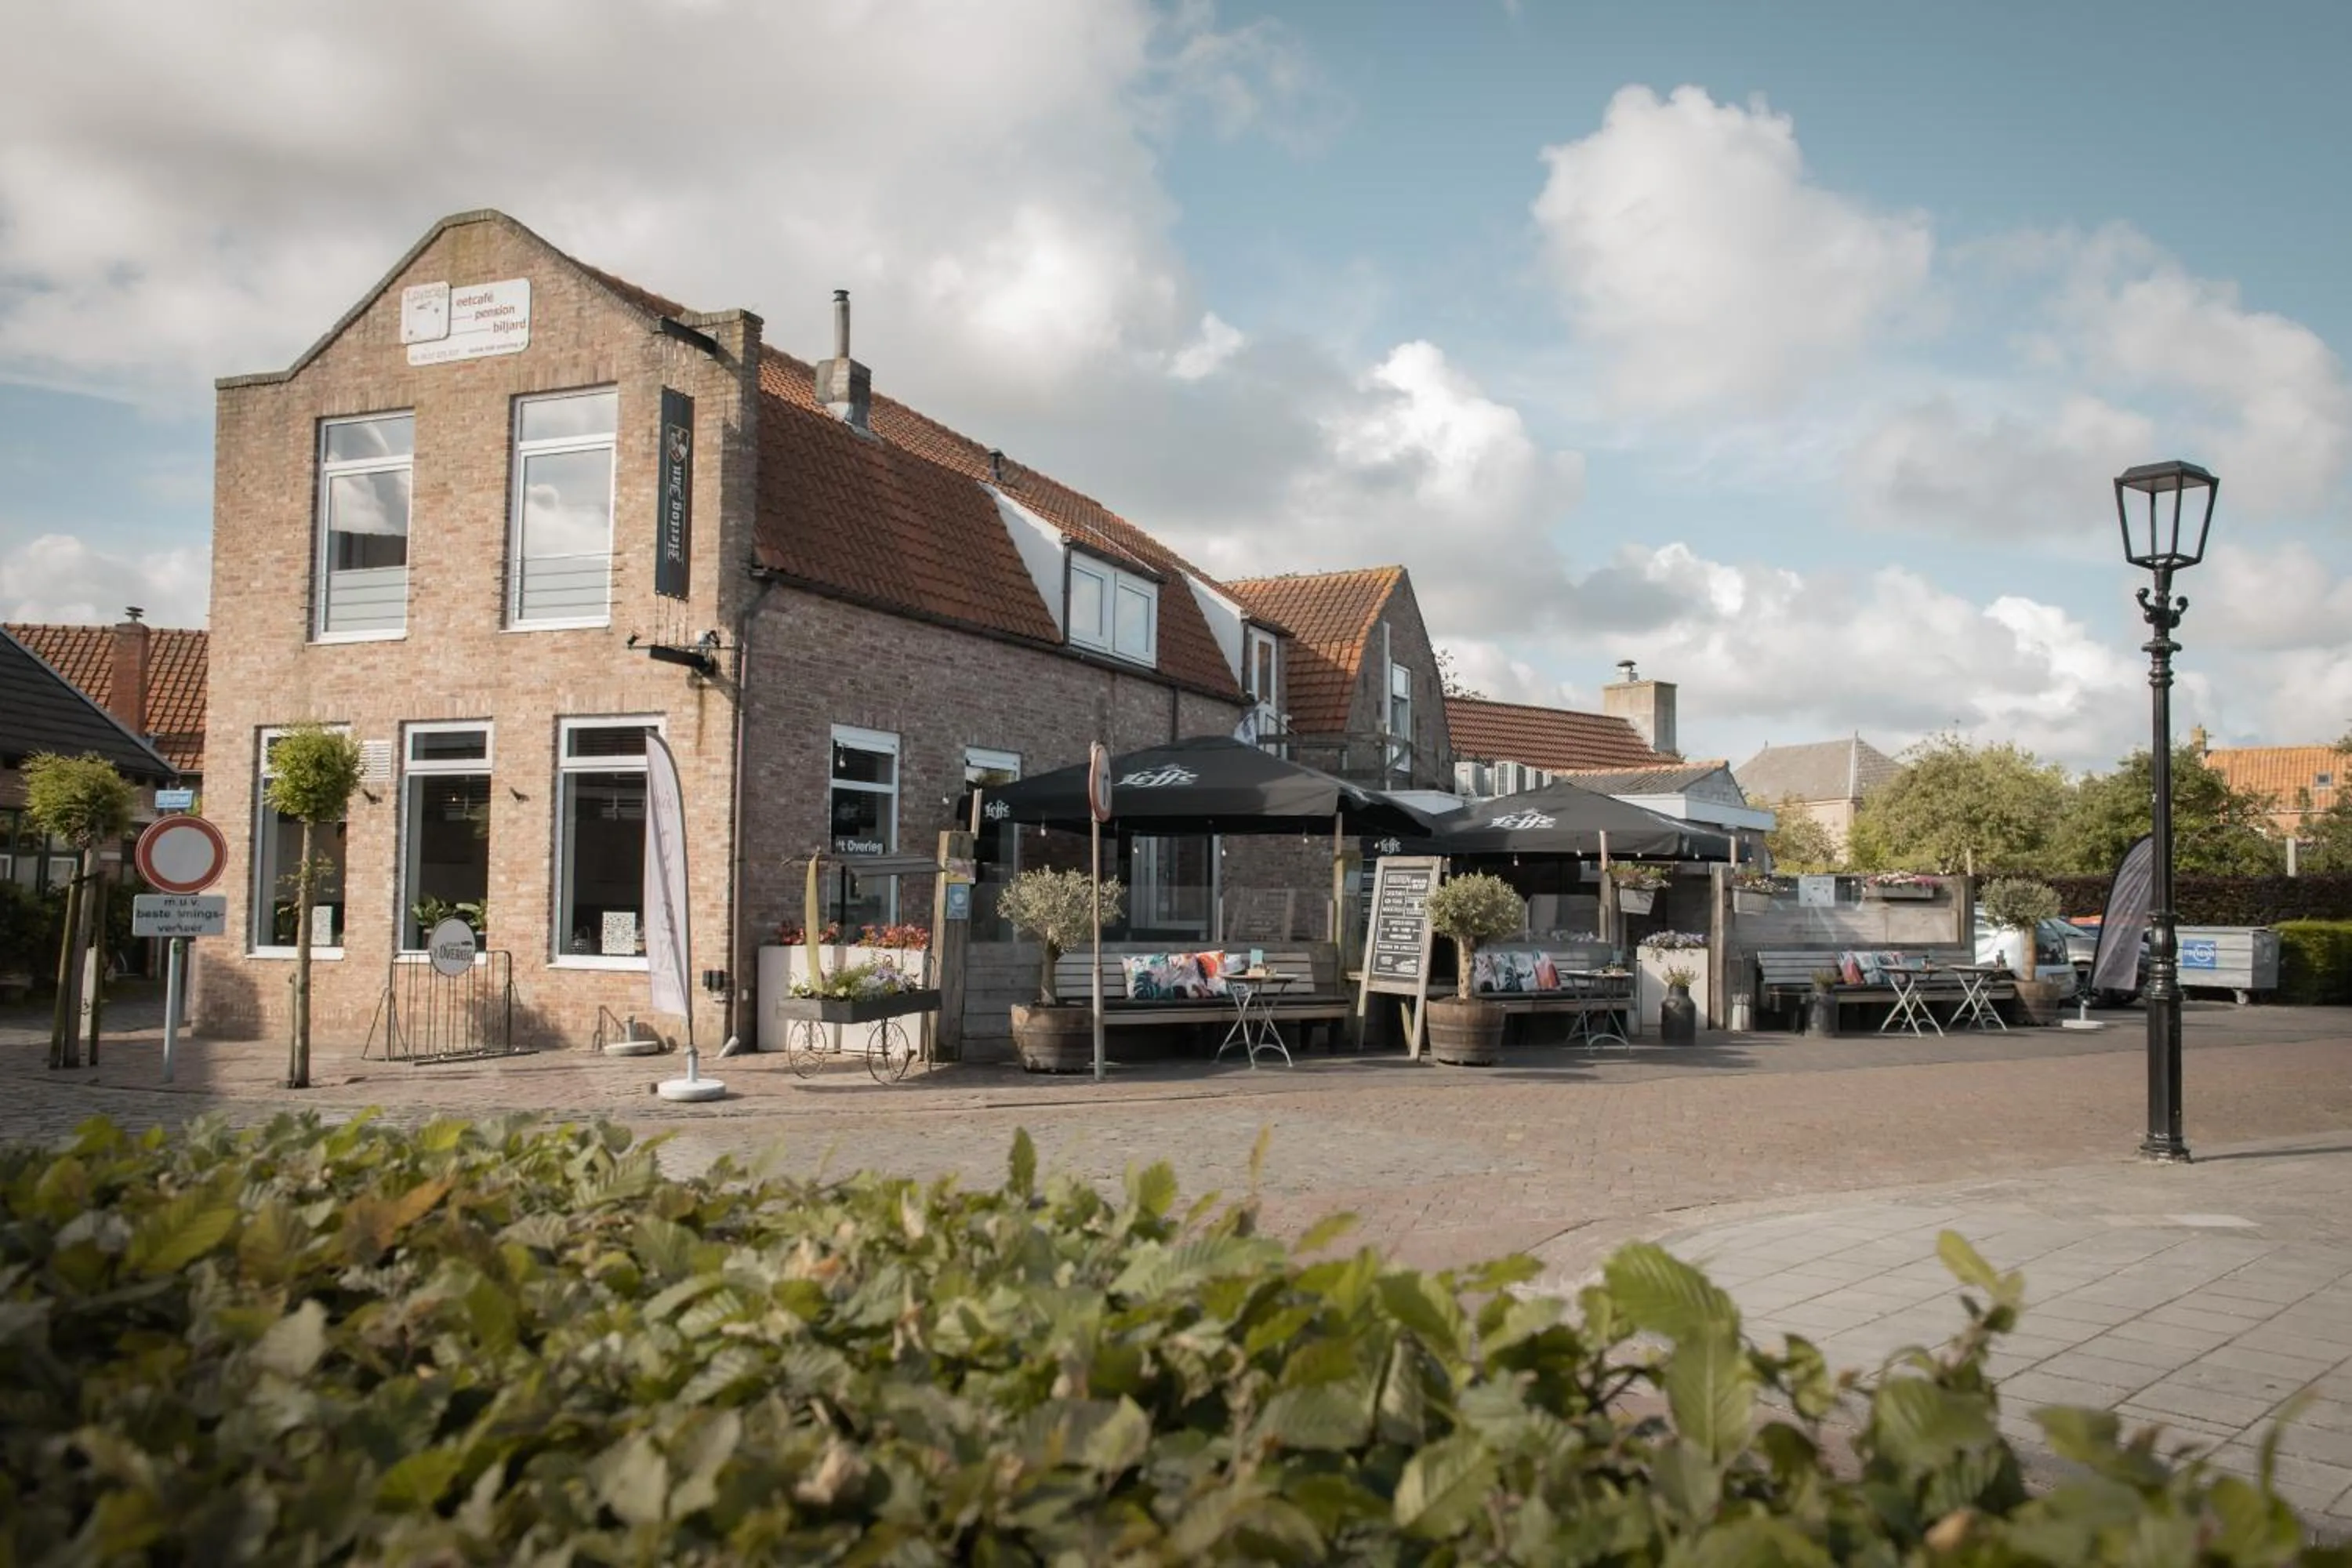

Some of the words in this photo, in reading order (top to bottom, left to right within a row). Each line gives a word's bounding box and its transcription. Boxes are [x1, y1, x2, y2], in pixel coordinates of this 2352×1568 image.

[474, 304, 515, 321] pension
[492, 318, 526, 333] biljard
[669, 466, 684, 502] Jan
[667, 500, 684, 566] Hertog
[848, 840, 884, 855] Overleg
